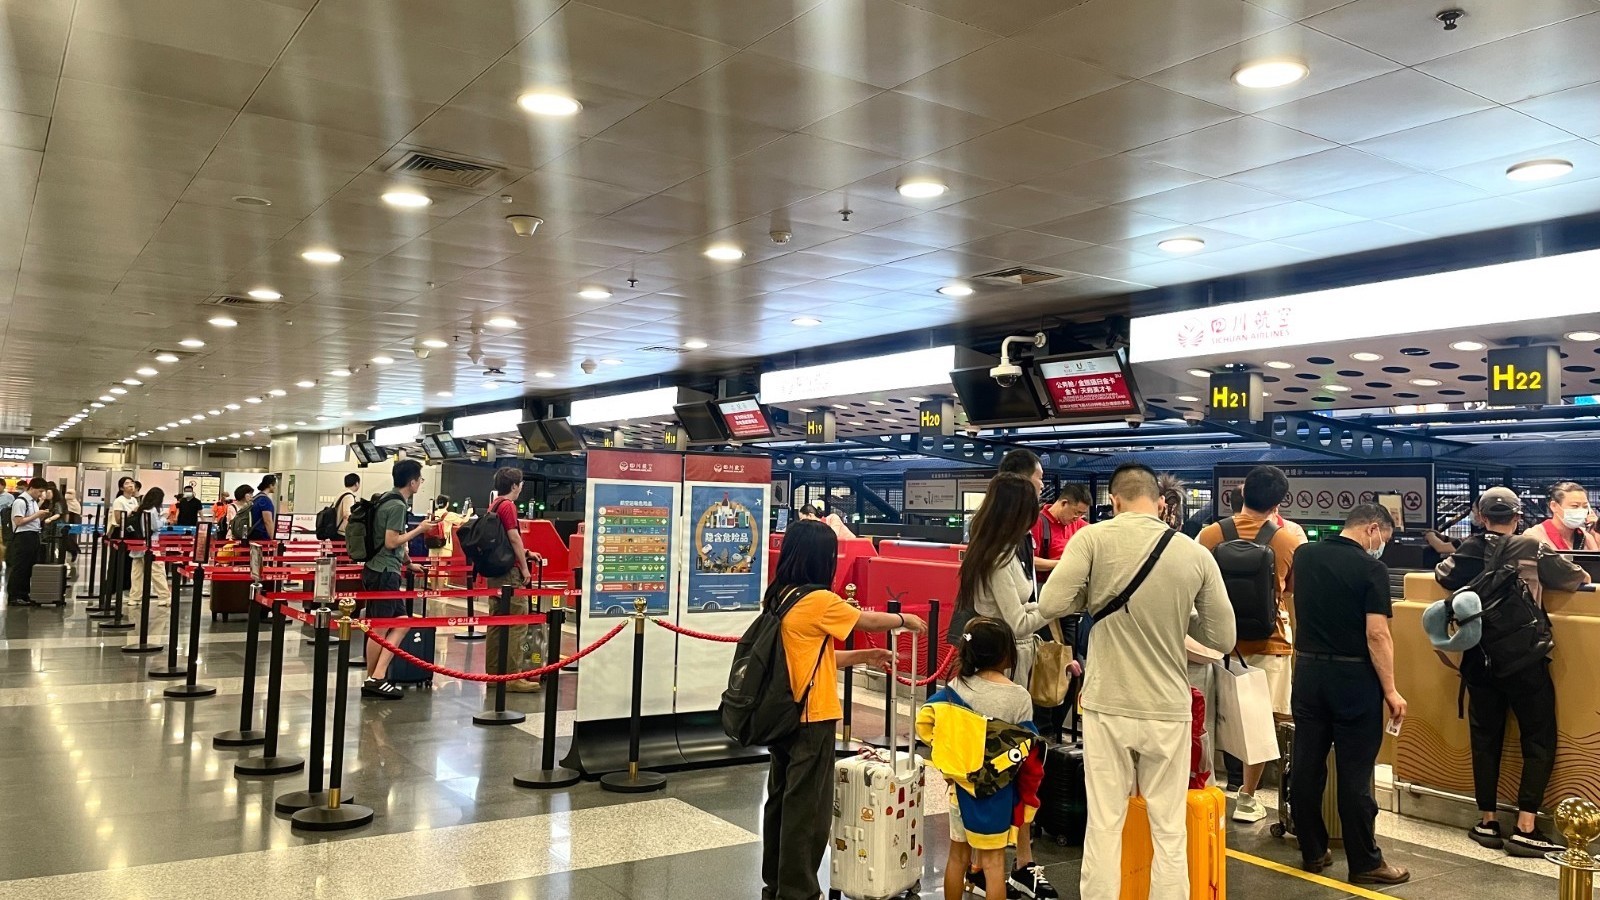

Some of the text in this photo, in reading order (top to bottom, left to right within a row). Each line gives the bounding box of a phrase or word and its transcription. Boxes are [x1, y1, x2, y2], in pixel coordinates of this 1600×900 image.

[1210, 307, 1292, 333] 四川航空
[1211, 329, 1291, 345] SICHUAN AIRLINES
[1493, 364, 1542, 391] H22
[1212, 386, 1247, 408] H21
[921, 411, 940, 427] H20
[807, 421, 823, 435] H19
[704, 532, 749, 543] 隐含危险品
